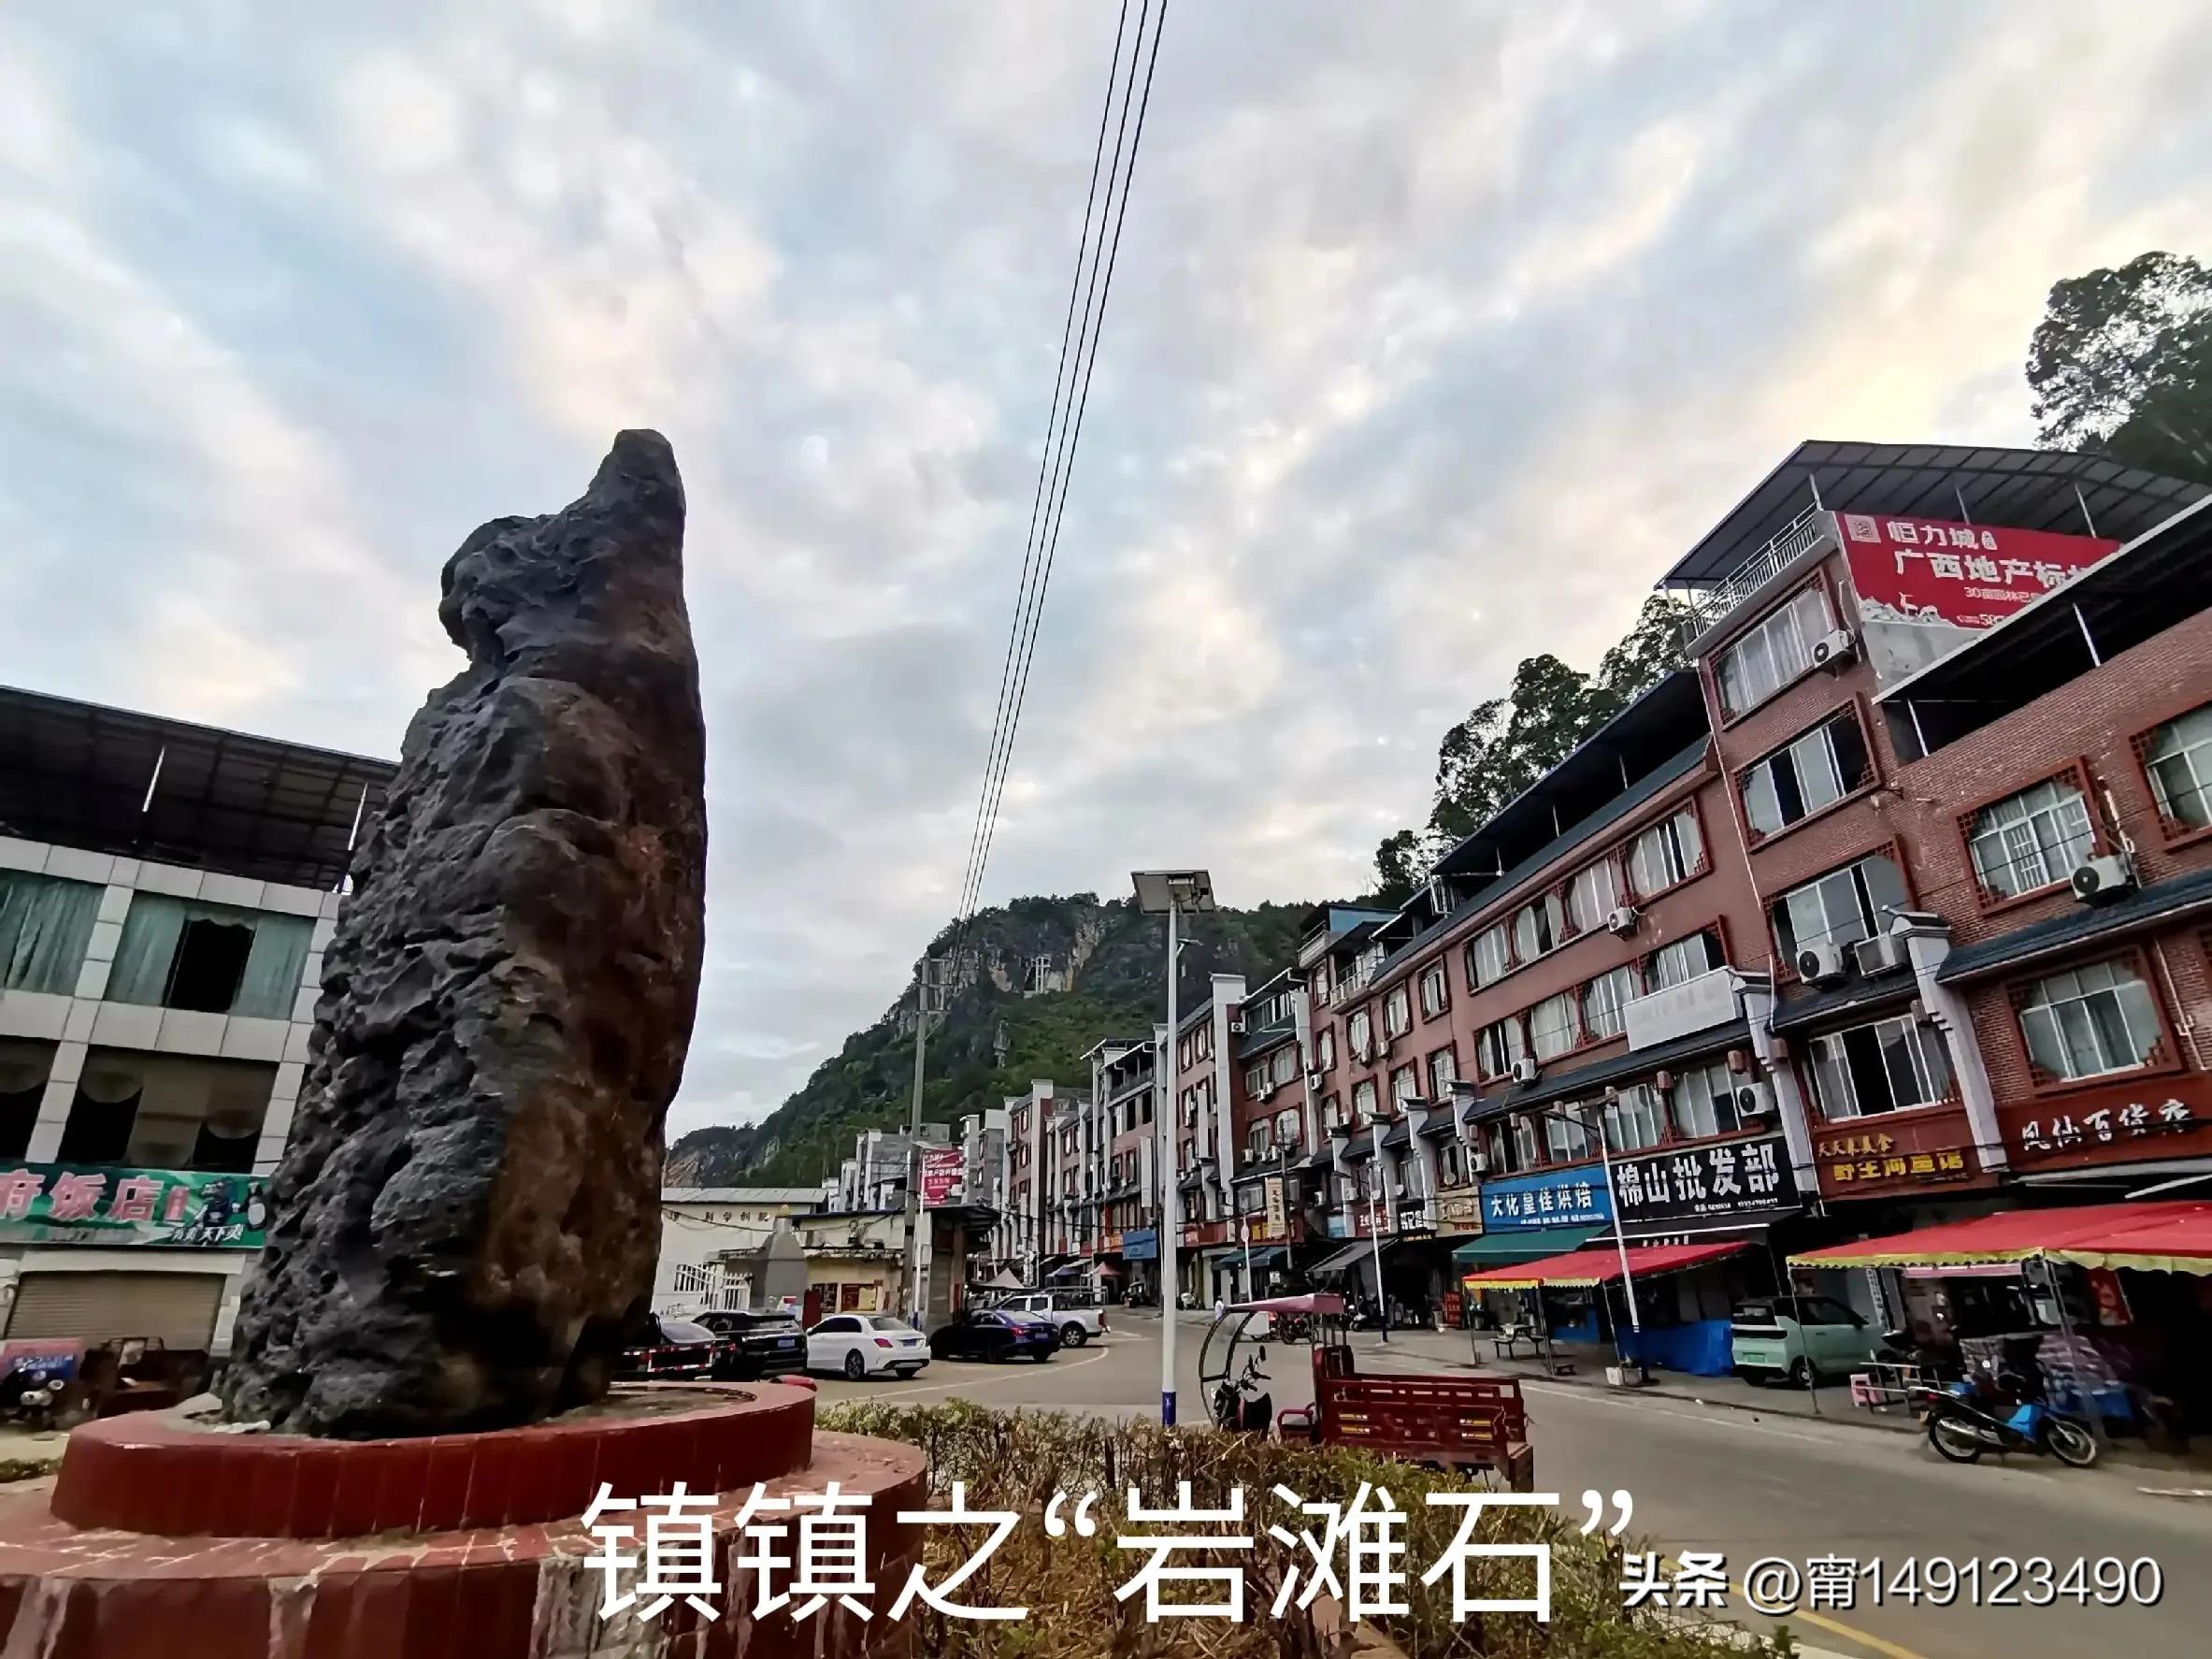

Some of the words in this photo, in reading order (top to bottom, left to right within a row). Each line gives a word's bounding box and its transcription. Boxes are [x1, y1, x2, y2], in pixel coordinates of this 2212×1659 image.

[1616, 1143, 1780, 1208] 棉山批发部
